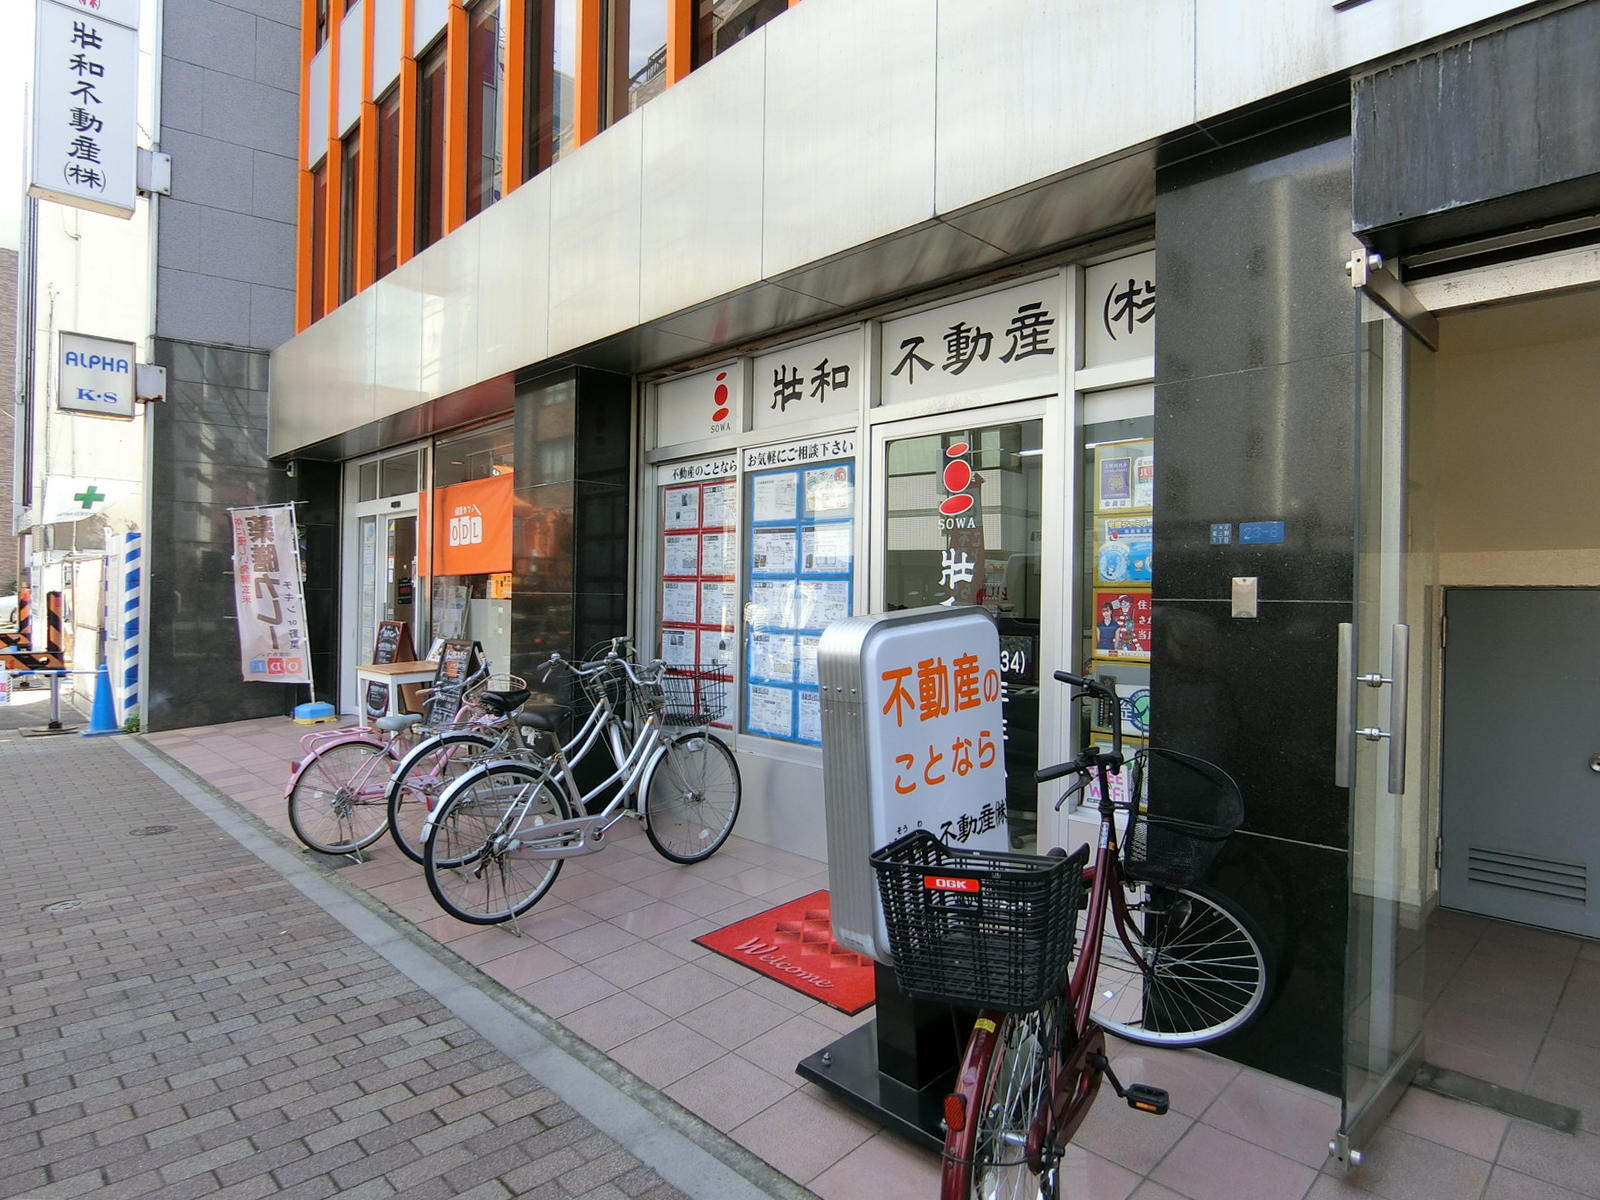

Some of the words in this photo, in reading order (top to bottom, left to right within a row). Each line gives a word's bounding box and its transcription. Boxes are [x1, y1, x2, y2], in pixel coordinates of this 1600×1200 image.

[890, 301, 1057, 385] 不動産
[65, 351, 129, 374] ALPHA
[710, 422, 731, 434] SOWA
[747, 439, 854, 467] お気軽にご相談下さい
[671, 460, 737, 481] 不動産のことなら
[451, 520, 480, 542] ODL
[938, 517, 976, 530] SOWA
[1137, 599, 1151, 610] 住
[881, 652, 999, 728] 不動産の
[895, 730, 997, 795] ことなら
[896, 826, 908, 836] そう
[935, 878, 967, 890] OGK
[734, 936, 835, 990] Welcome
